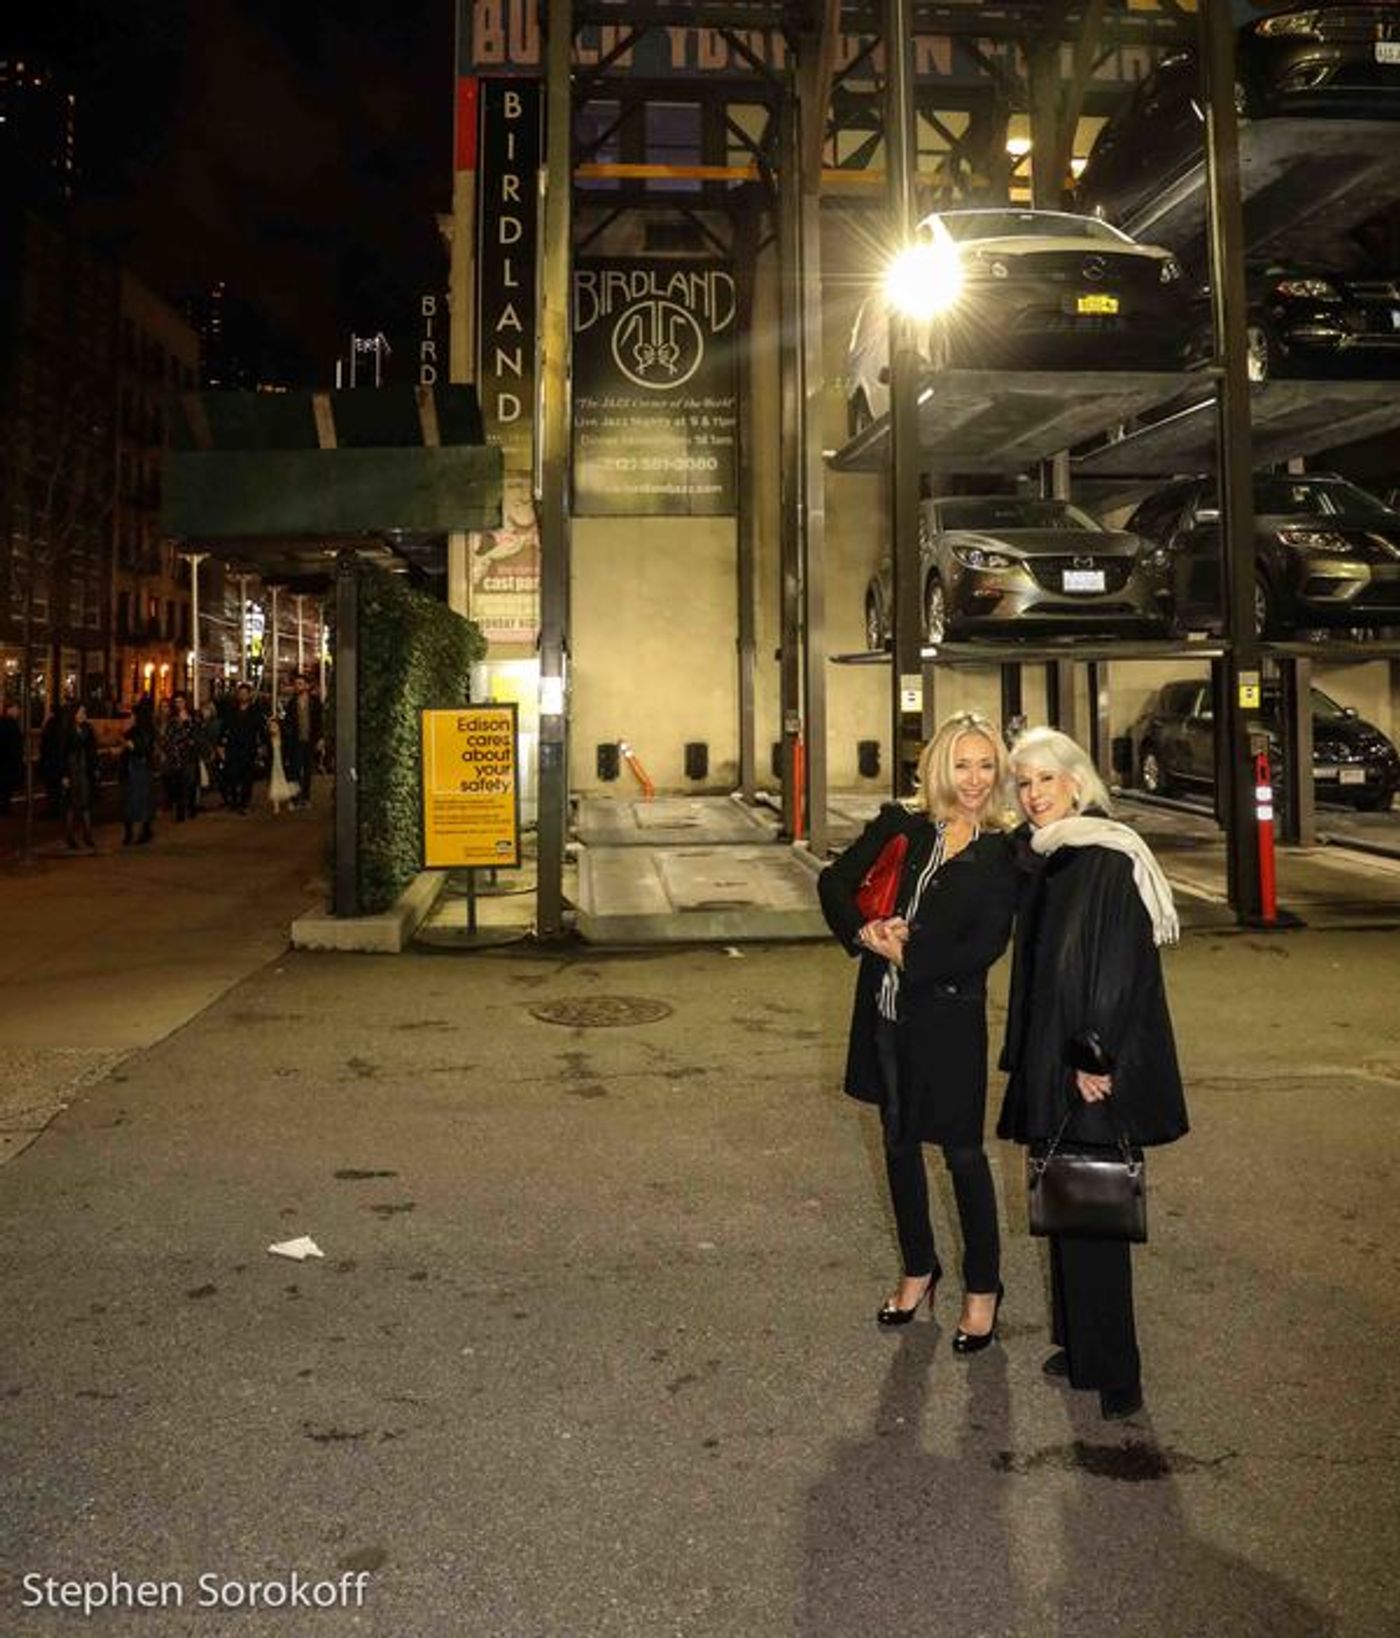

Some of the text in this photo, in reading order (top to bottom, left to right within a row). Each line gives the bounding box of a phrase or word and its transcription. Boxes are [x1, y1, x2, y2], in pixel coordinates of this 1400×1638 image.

[473, 0, 634, 66] BULD
[496, 91, 523, 421] BIRDLAND
[573, 270, 736, 333] BIRDLAND
[420, 296, 437, 384] BIRD
[457, 716, 510, 732] Edison
[466, 734, 510, 747] cares
[461, 749, 511, 762] about
[474, 764, 511, 778] your
[460, 779, 511, 794] safety
